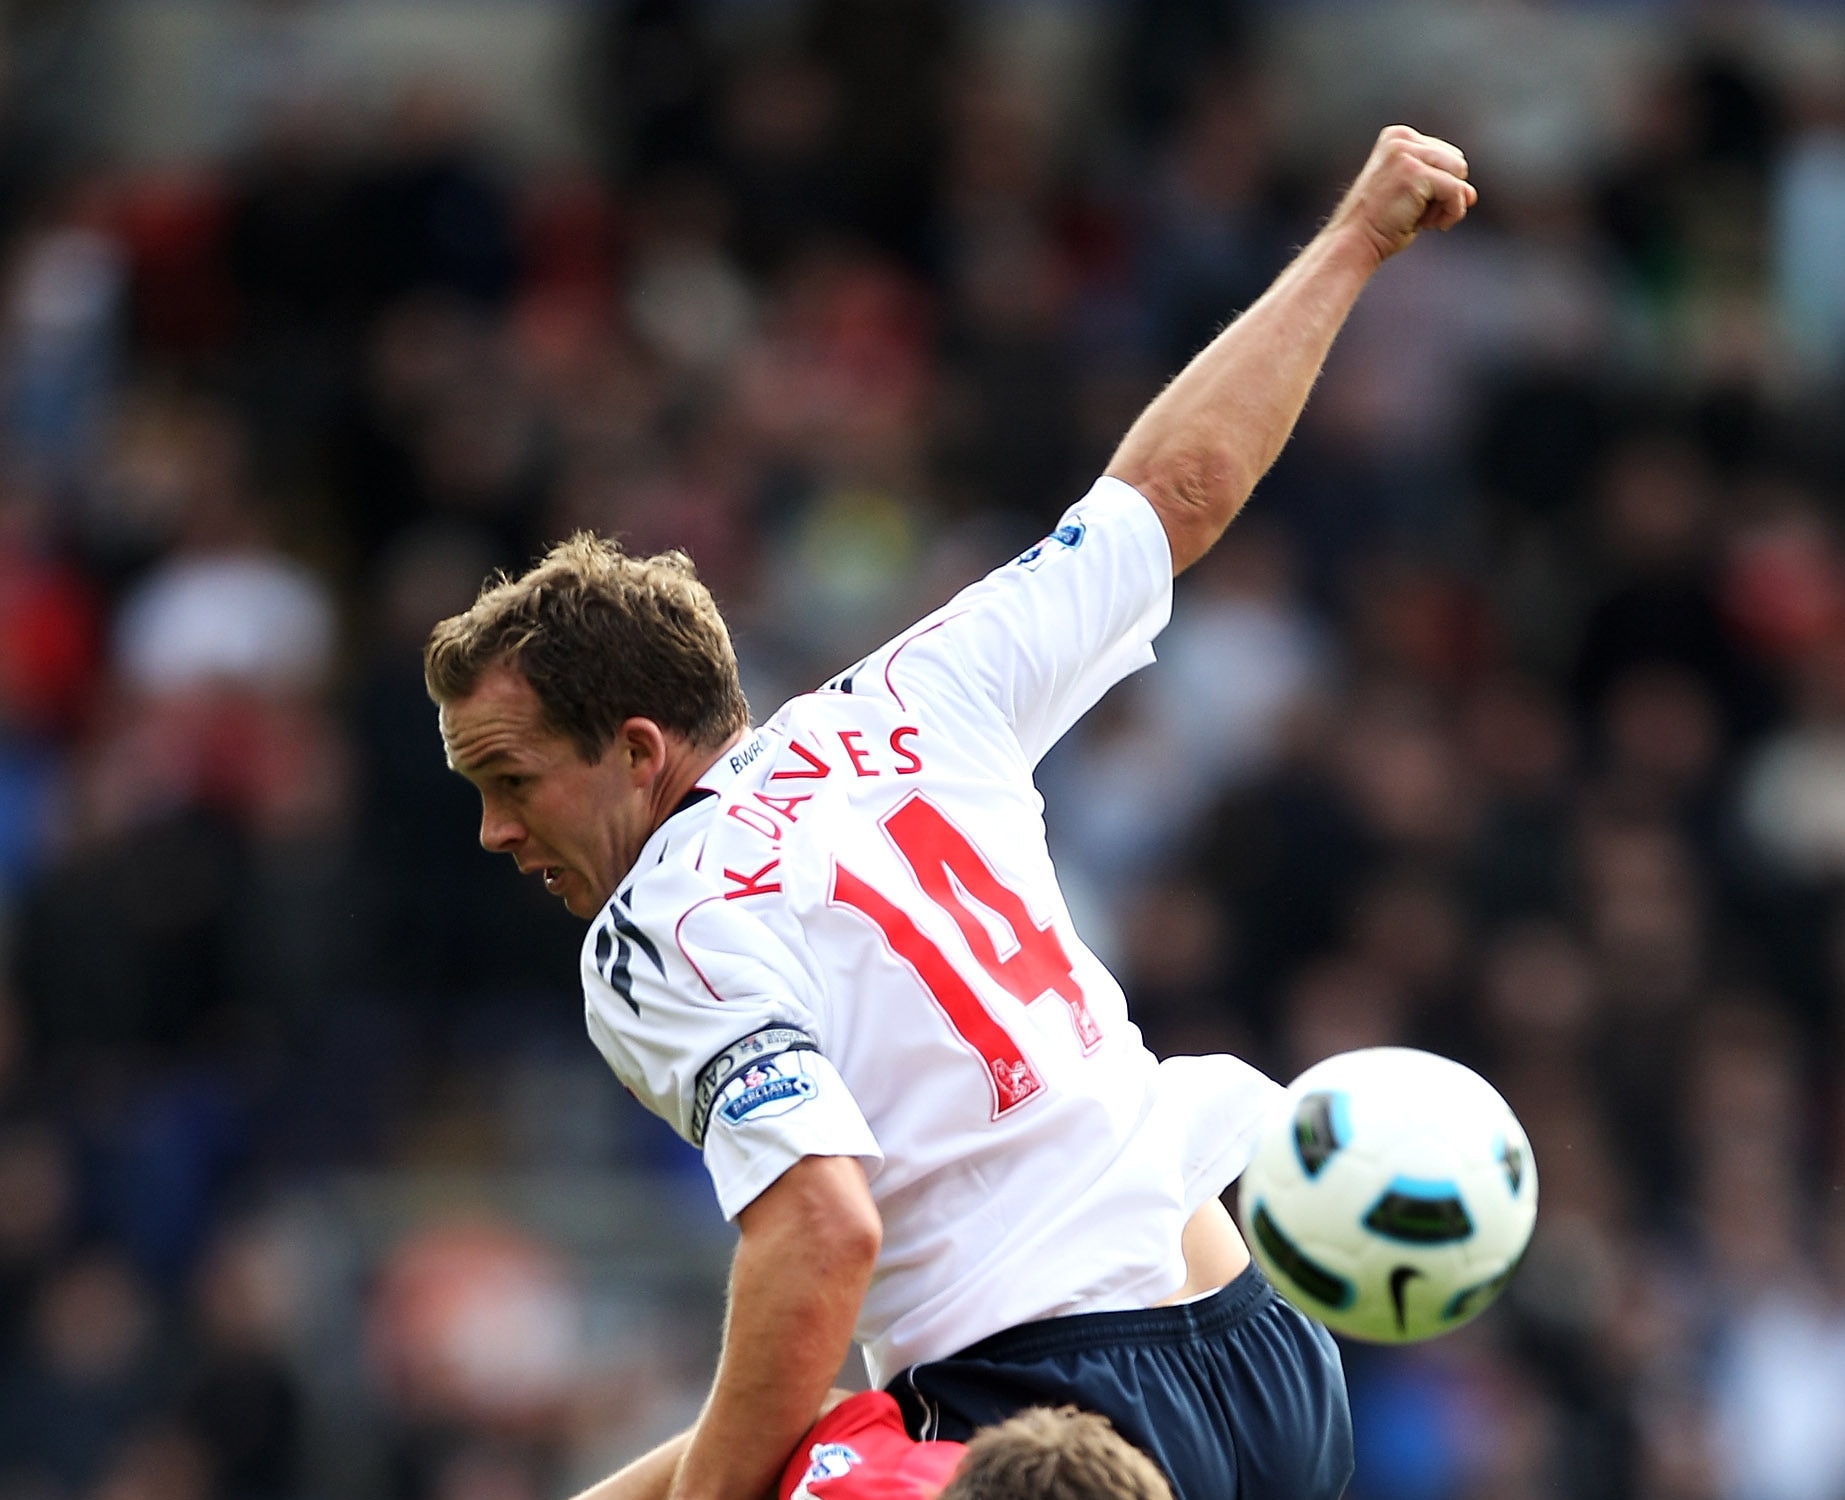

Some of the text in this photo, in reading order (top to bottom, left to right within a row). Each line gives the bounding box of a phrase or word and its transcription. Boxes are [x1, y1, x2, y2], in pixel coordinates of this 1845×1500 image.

[724, 727, 922, 900] K.DAVES
[826, 788, 1103, 1121] 14
[732, 1082, 792, 1114] BARCLAYS
